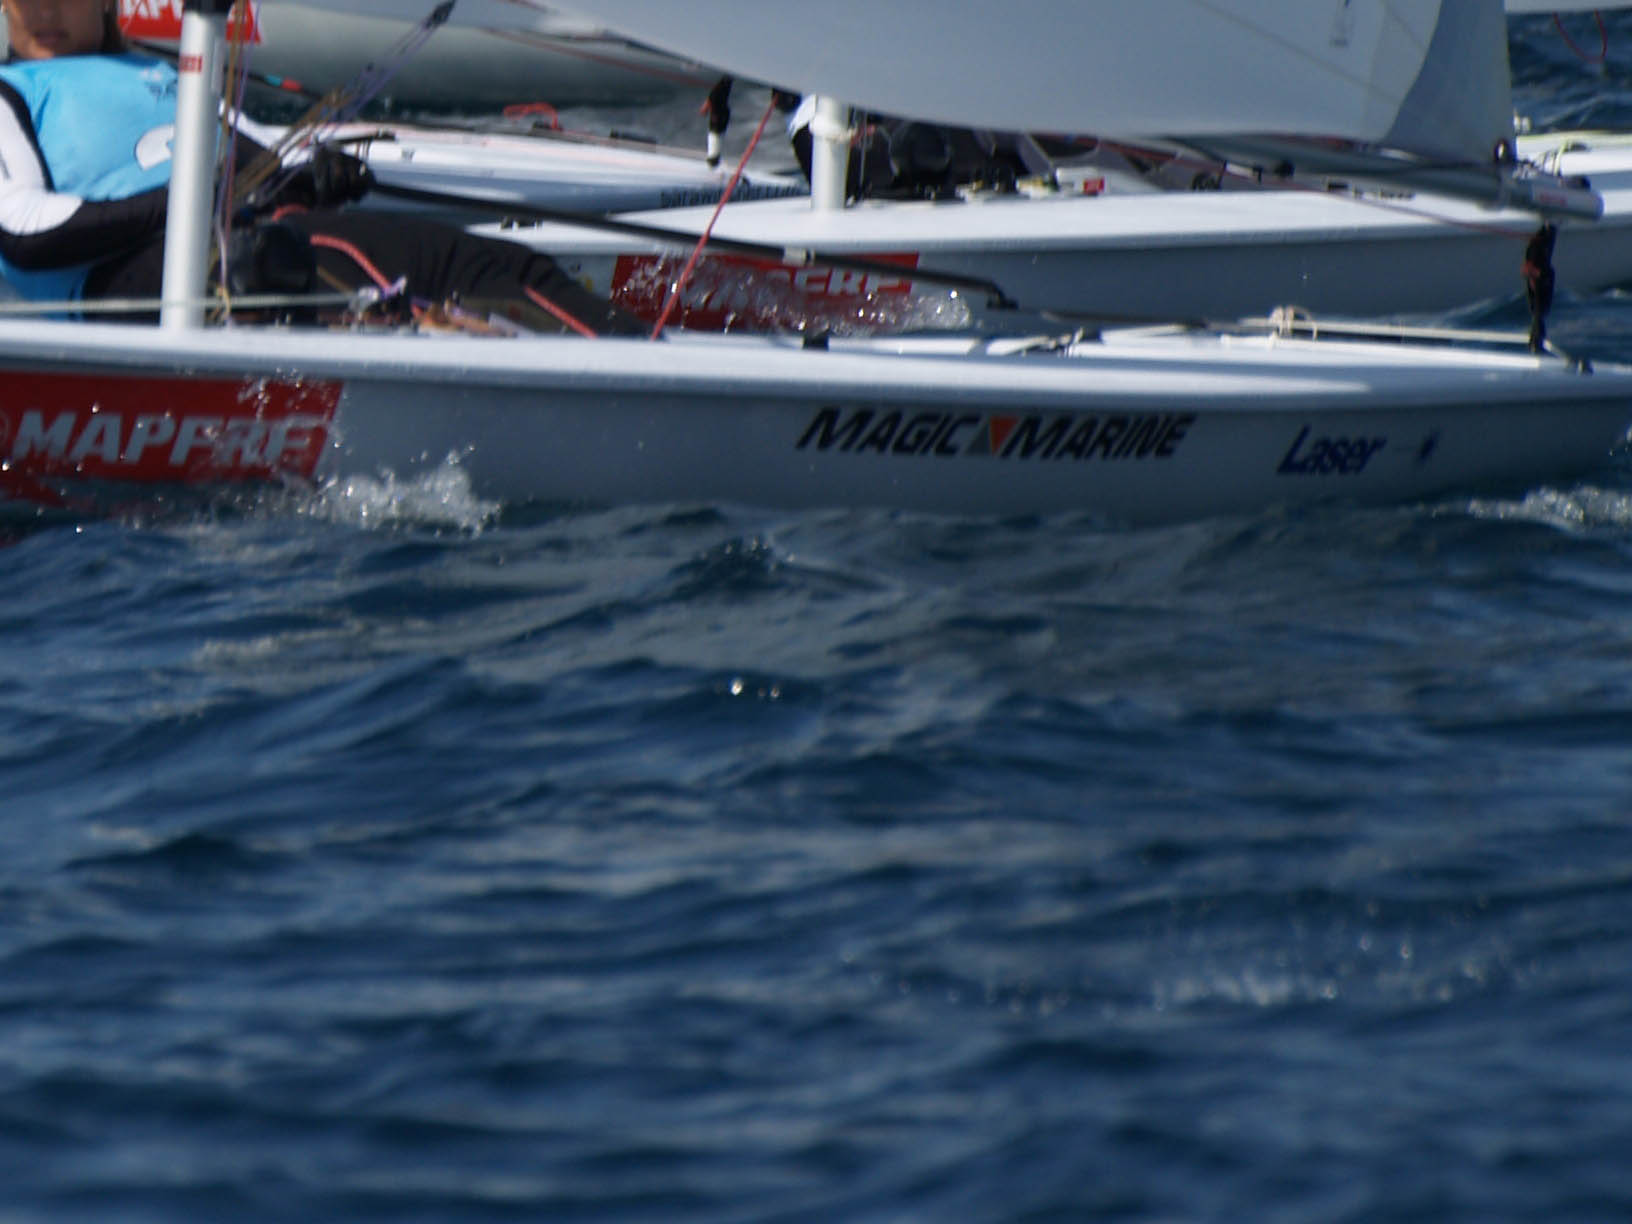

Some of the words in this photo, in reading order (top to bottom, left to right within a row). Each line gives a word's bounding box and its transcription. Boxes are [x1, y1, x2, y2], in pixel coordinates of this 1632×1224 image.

[9, 410, 328, 467] MAPFRE
[795, 407, 982, 457] MAGIC
[999, 412, 1197, 461] MARINE
[1276, 423, 1389, 474] Laser
